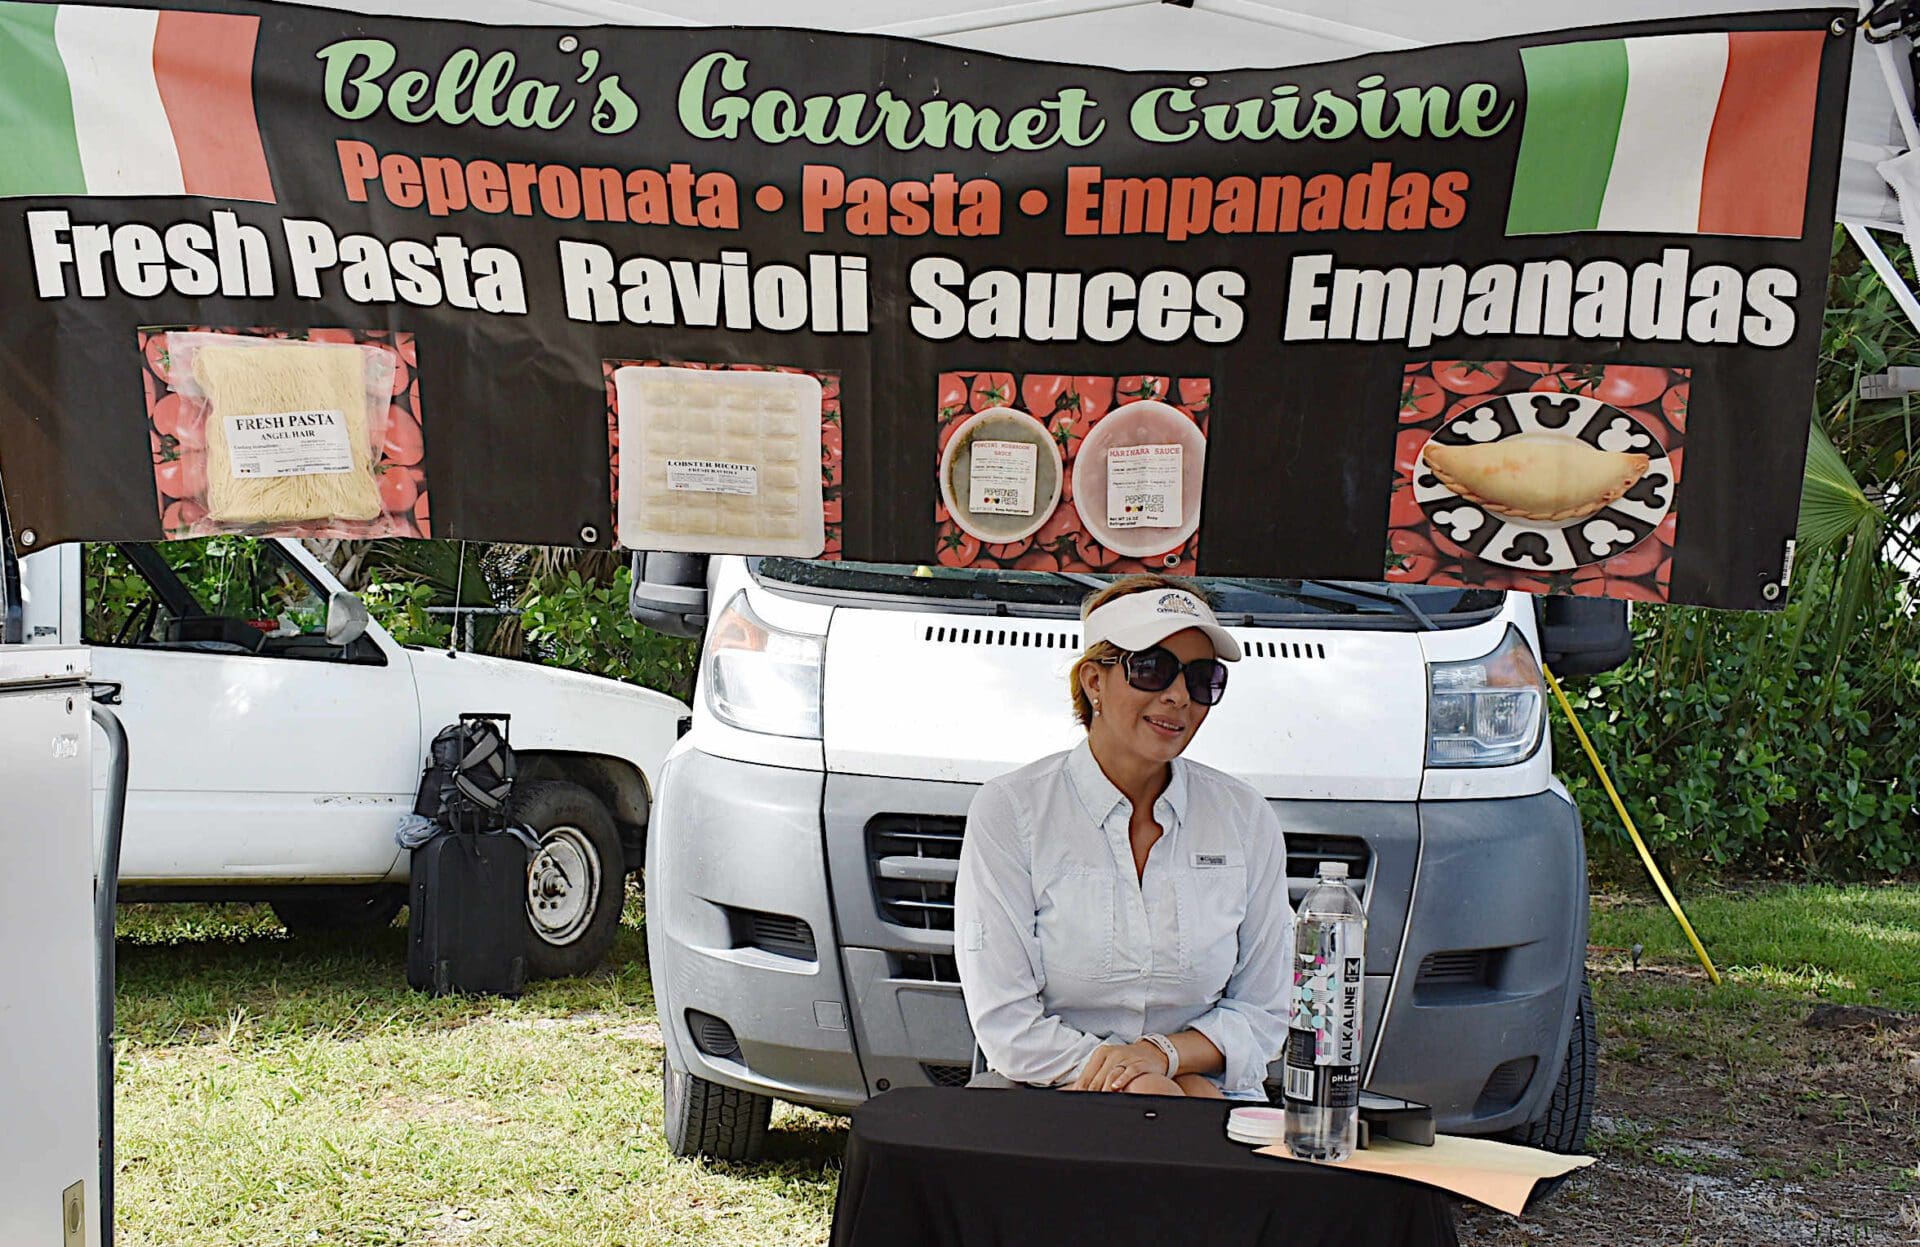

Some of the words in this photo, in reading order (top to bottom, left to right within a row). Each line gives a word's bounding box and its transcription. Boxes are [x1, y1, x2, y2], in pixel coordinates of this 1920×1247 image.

[318, 40, 638, 134] Bella's
[679, 53, 1105, 152] Gourmet
[1130, 75, 1514, 142] Cuisine
[336, 140, 739, 230] Peperonata
[803, 165, 1001, 236] Pasta
[1065, 162, 1469, 241] Empanadas
[27, 210, 274, 298] Fresh
[282, 217, 527, 314] Pasta
[559, 241, 868, 332] Ravioli
[910, 257, 1245, 342] Sauces
[1284, 248, 1797, 348] Empanadas
[236, 416, 285, 431] FRESH
[289, 413, 335, 427] PASTA
[261, 431, 290, 441] ANGEL
[292, 430, 316, 439] HAIR
[1109, 448, 1150, 457] MARINARA
[1154, 447, 1180, 455] SAUCE
[668, 460, 712, 468] LOBSTER
[714, 463, 757, 471] RICOTTA
[1341, 986, 1356, 1062] ALKALINE
[1331, 1074, 1343, 1083] pH
